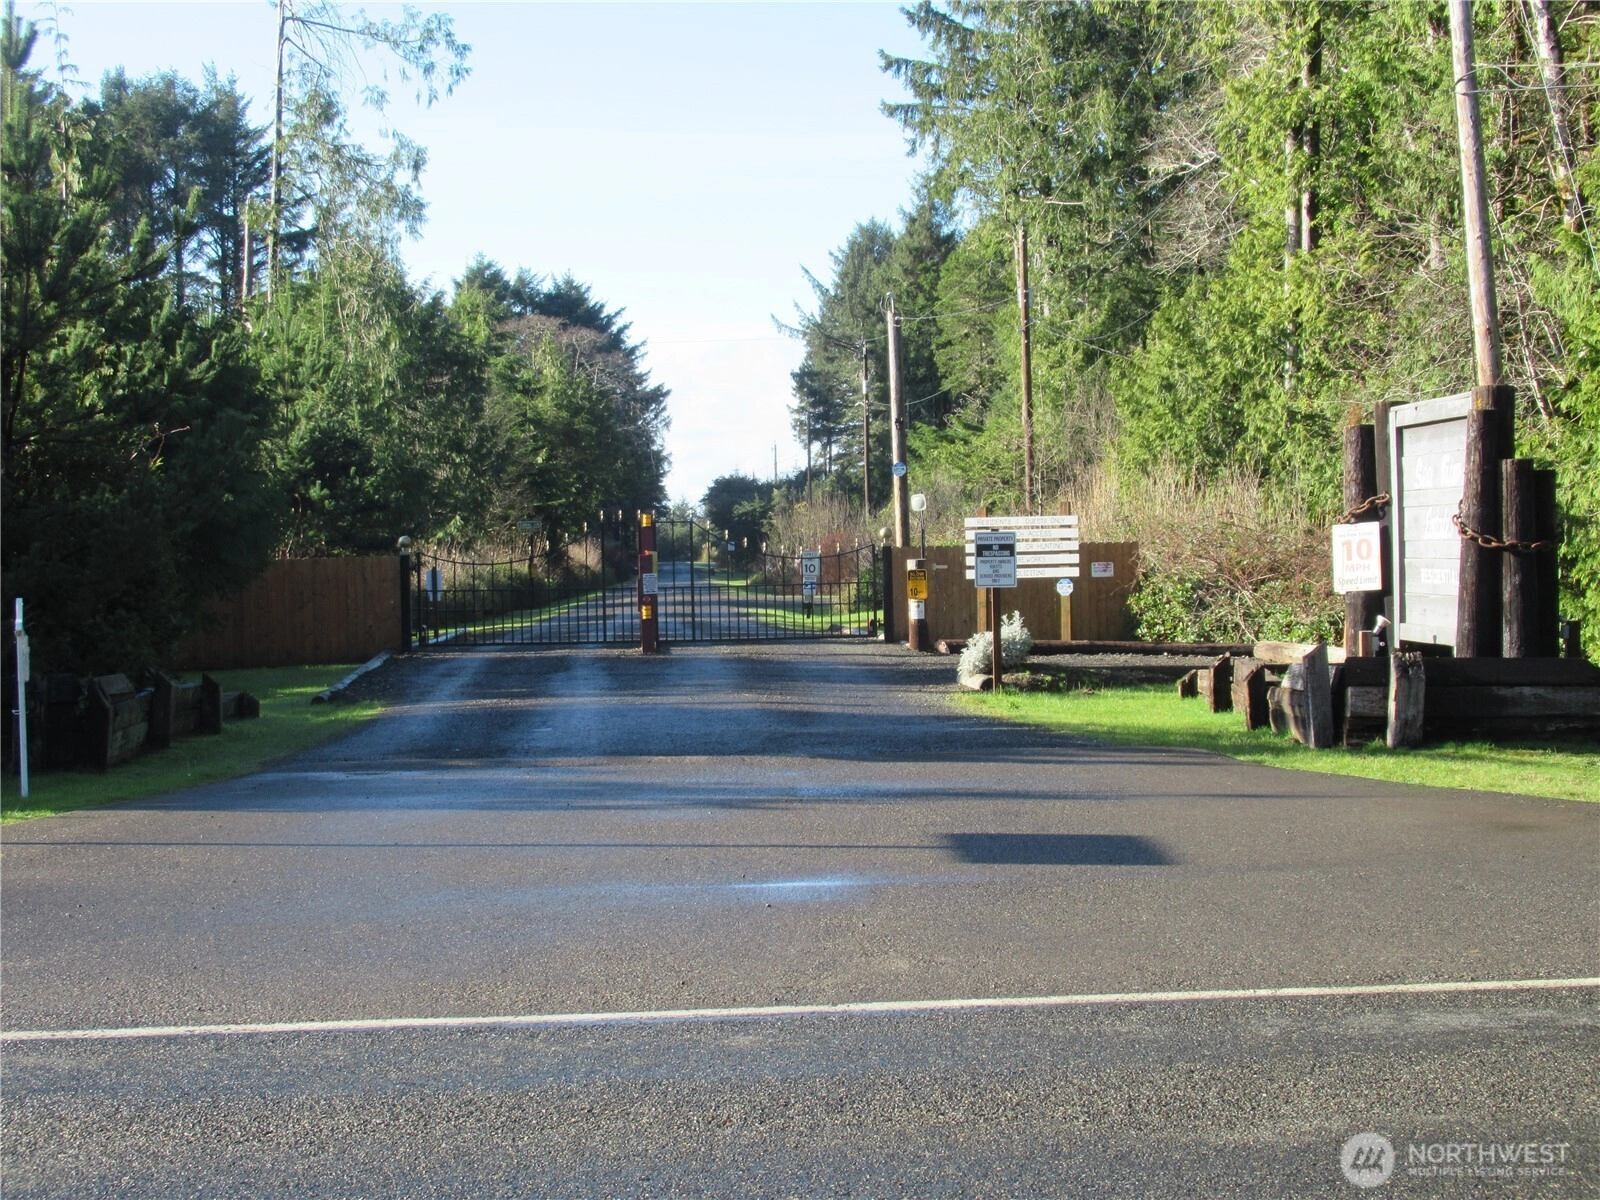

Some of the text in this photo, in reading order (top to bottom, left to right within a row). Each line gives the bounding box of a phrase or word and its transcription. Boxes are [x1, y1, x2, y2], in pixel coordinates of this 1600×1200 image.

[977, 518, 1011, 526] RESIDENTS
[1025, 517, 1048, 525] GUESTS
[1050, 516, 1066, 524] ONLY
[1028, 530, 1052, 538] ACCESS
[1037, 542, 1064, 550] HUNTING
[1341, 538, 1373, 562] 10
[804, 563, 816, 573] 10
[1345, 563, 1370, 572] MPH
[1338, 575, 1378, 588] Speed Limit
[910, 587, 918, 597] 10
